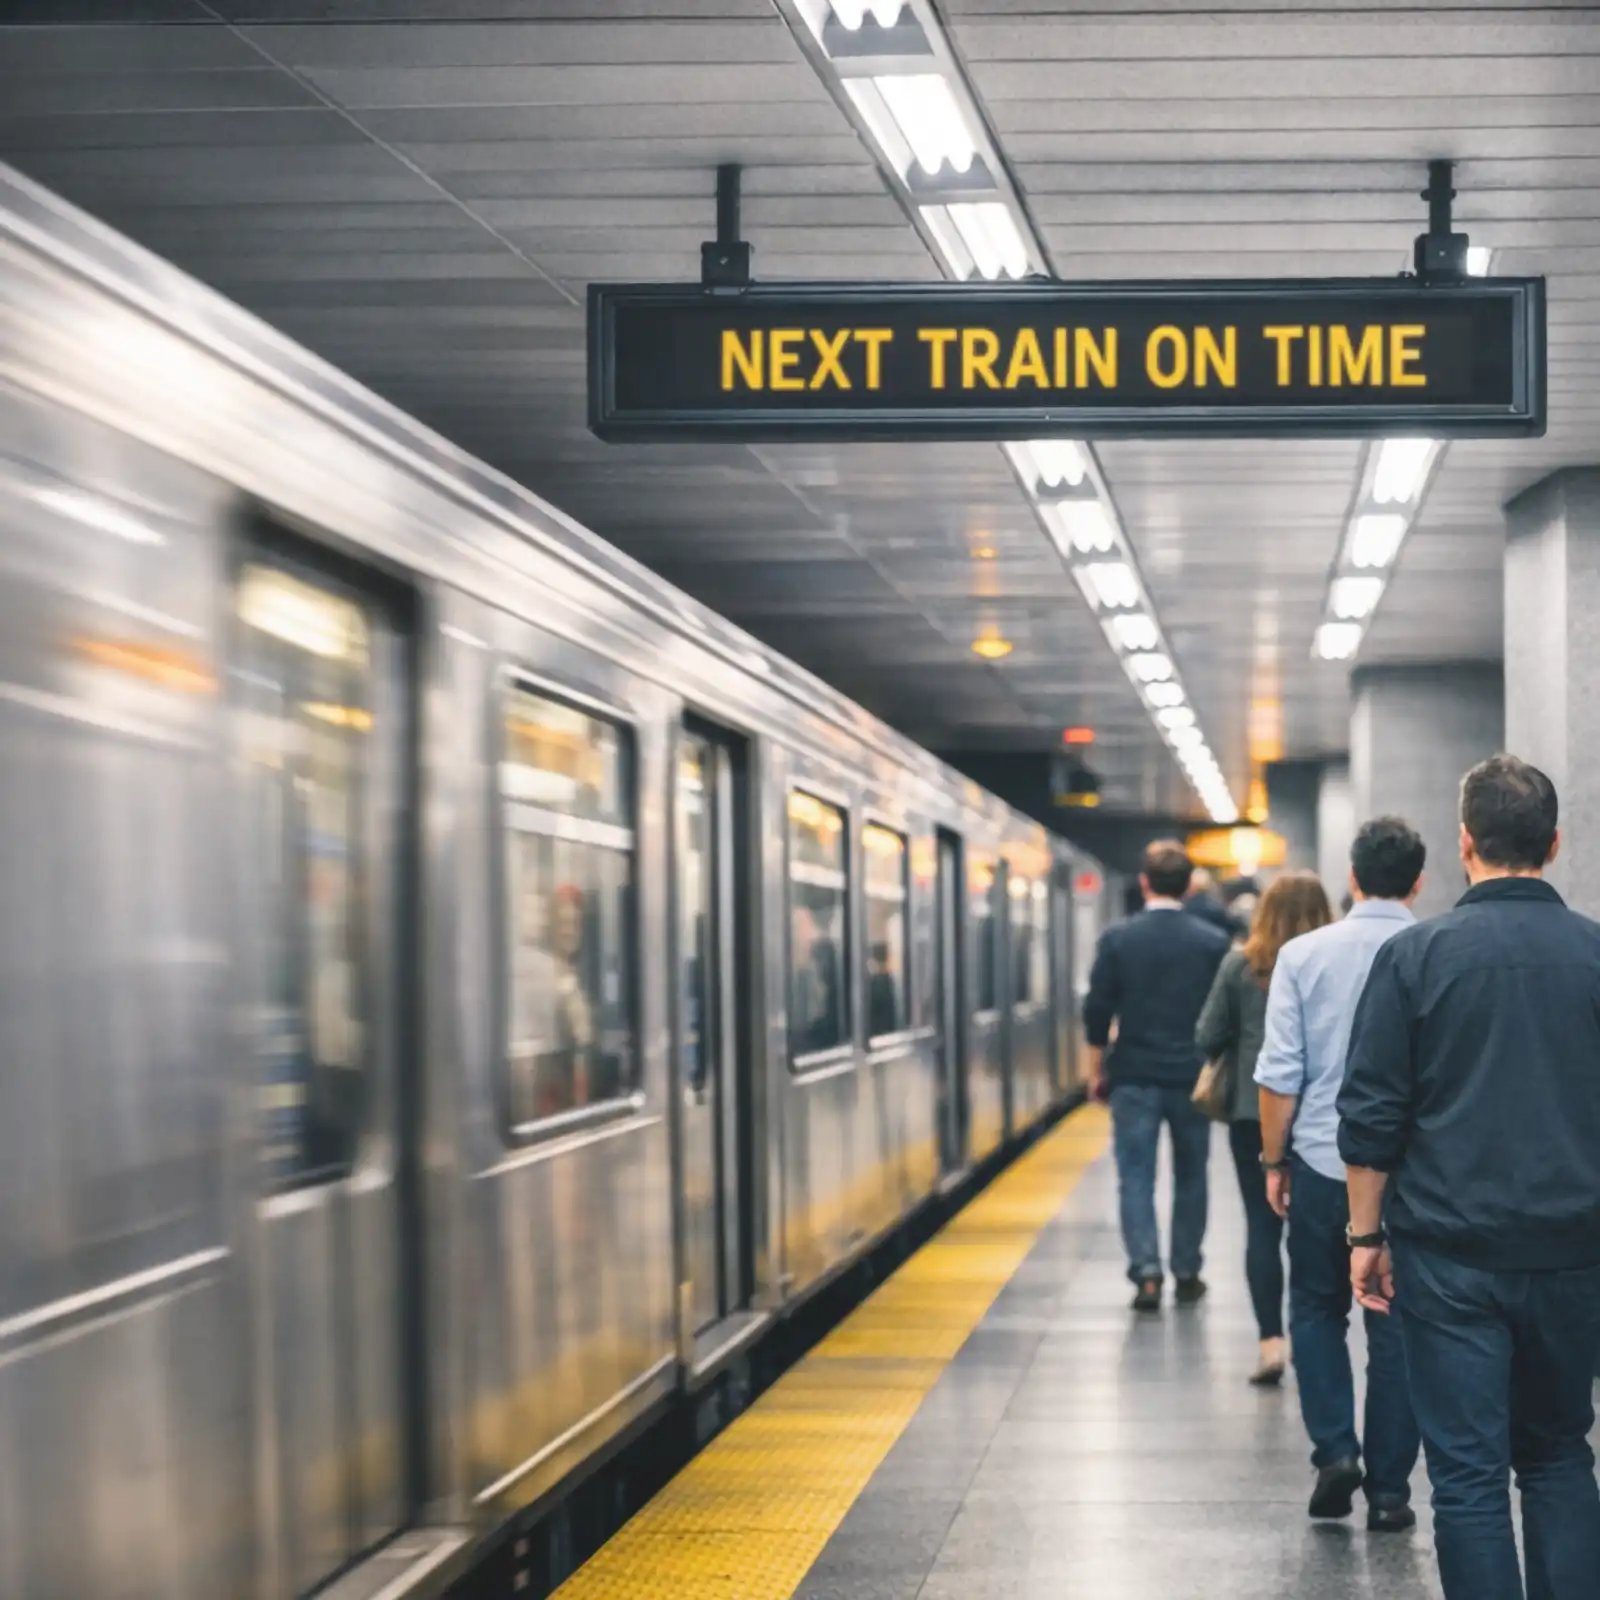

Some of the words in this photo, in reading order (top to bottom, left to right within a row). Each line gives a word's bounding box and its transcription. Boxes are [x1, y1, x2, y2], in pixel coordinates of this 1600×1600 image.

[720, 327, 893, 391] NEXT
[916, 326, 1118, 390] TRAIN
[1144, 325, 1238, 388] ON
[1263, 324, 1426, 387] TIME
